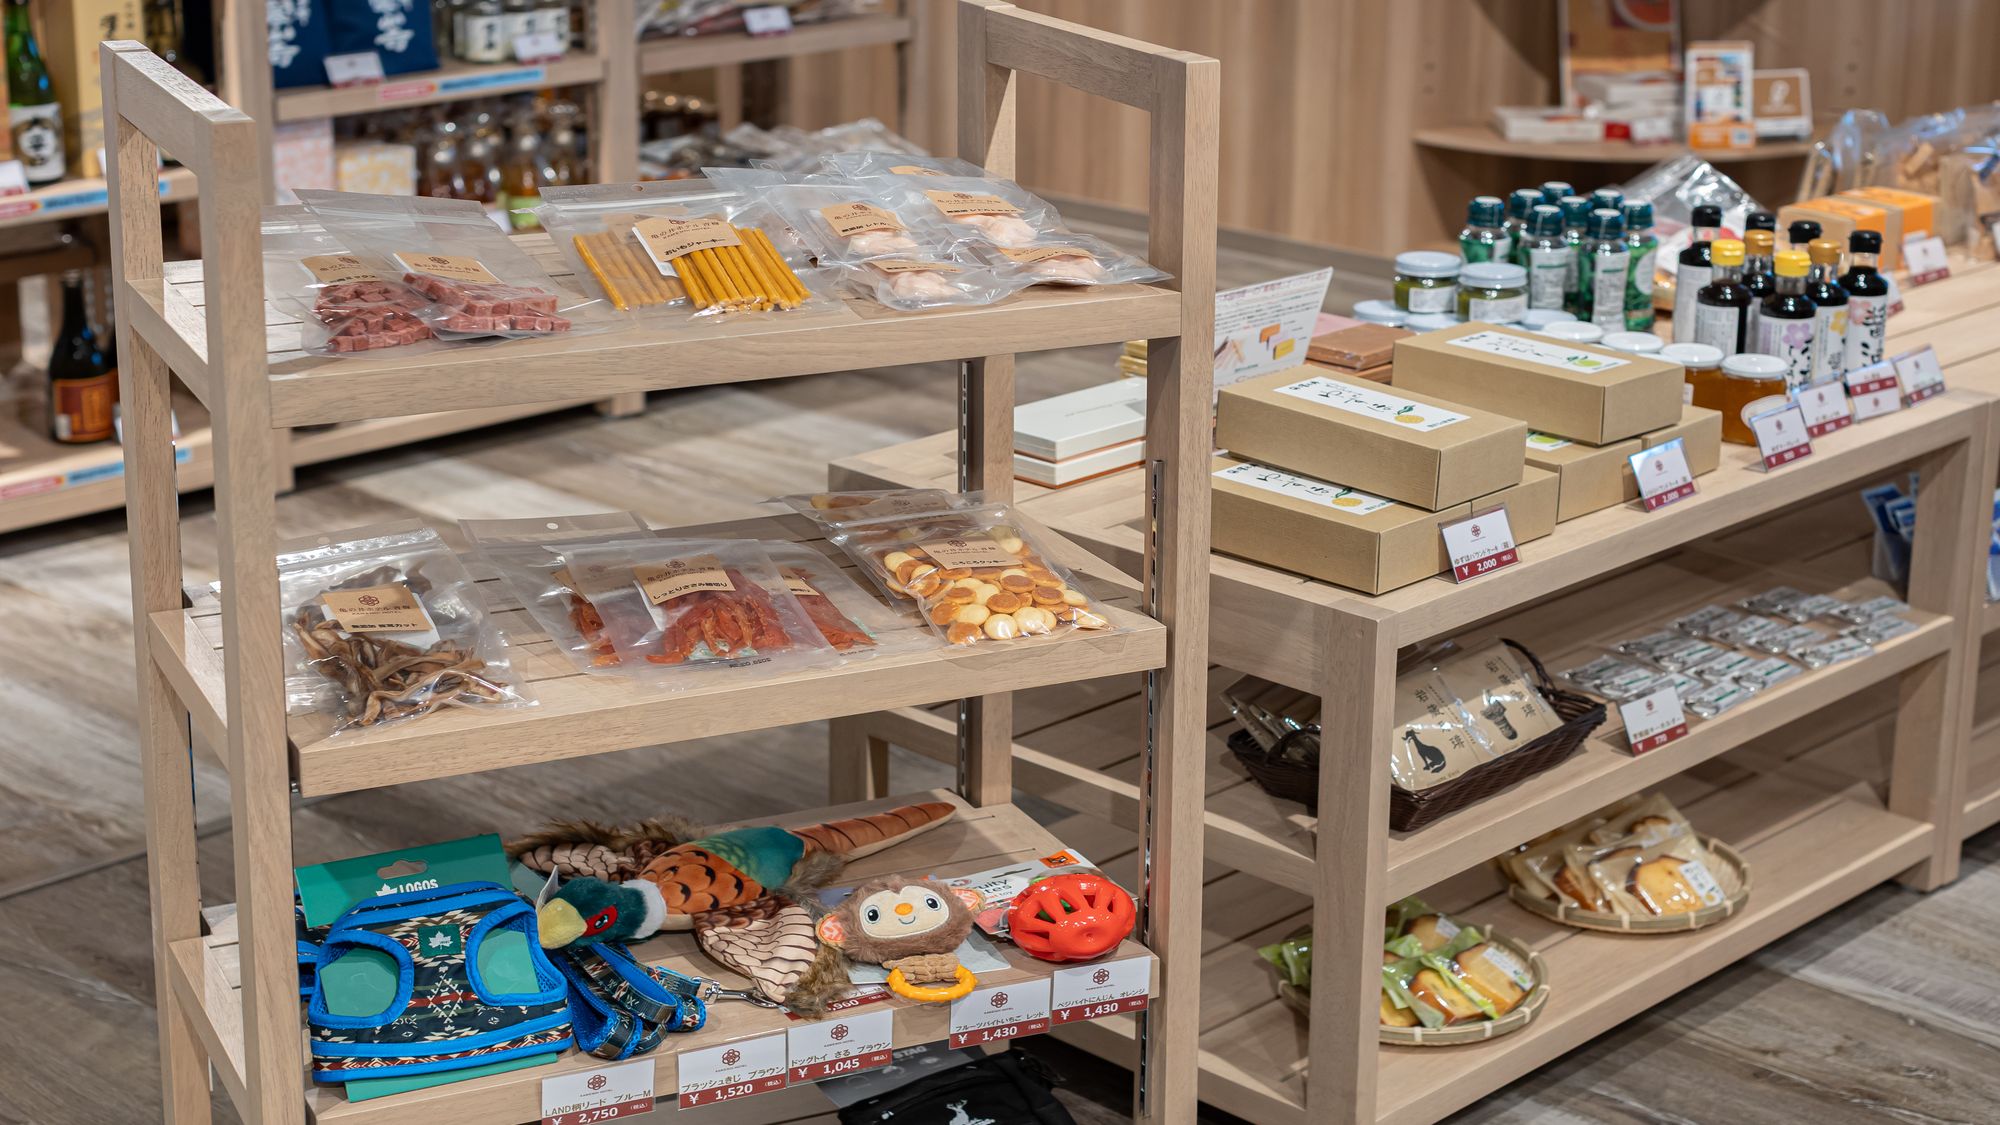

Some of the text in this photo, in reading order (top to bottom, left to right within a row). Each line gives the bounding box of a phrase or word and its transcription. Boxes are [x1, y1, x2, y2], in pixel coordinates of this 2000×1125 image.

[398, 878, 439, 894] LOGOS
[1060, 1009, 1071, 1021] ¥
[1083, 1002, 1119, 1018] 1,430
[957, 1033, 968, 1044] ¥
[982, 1026, 1018, 1042] 1,430
[791, 1042, 891, 1067] ドッグトイ さる ブラウン
[748, 1066, 785, 1080] ブラウン
[798, 1066, 808, 1078] ¥
[823, 1058, 860, 1074] 1,045
[689, 1092, 700, 1105] ¥
[715, 1083, 753, 1100] 1,520
[545, 1099, 607, 1117] LAND柄リード
[578, 1107, 619, 1124] 2,750
